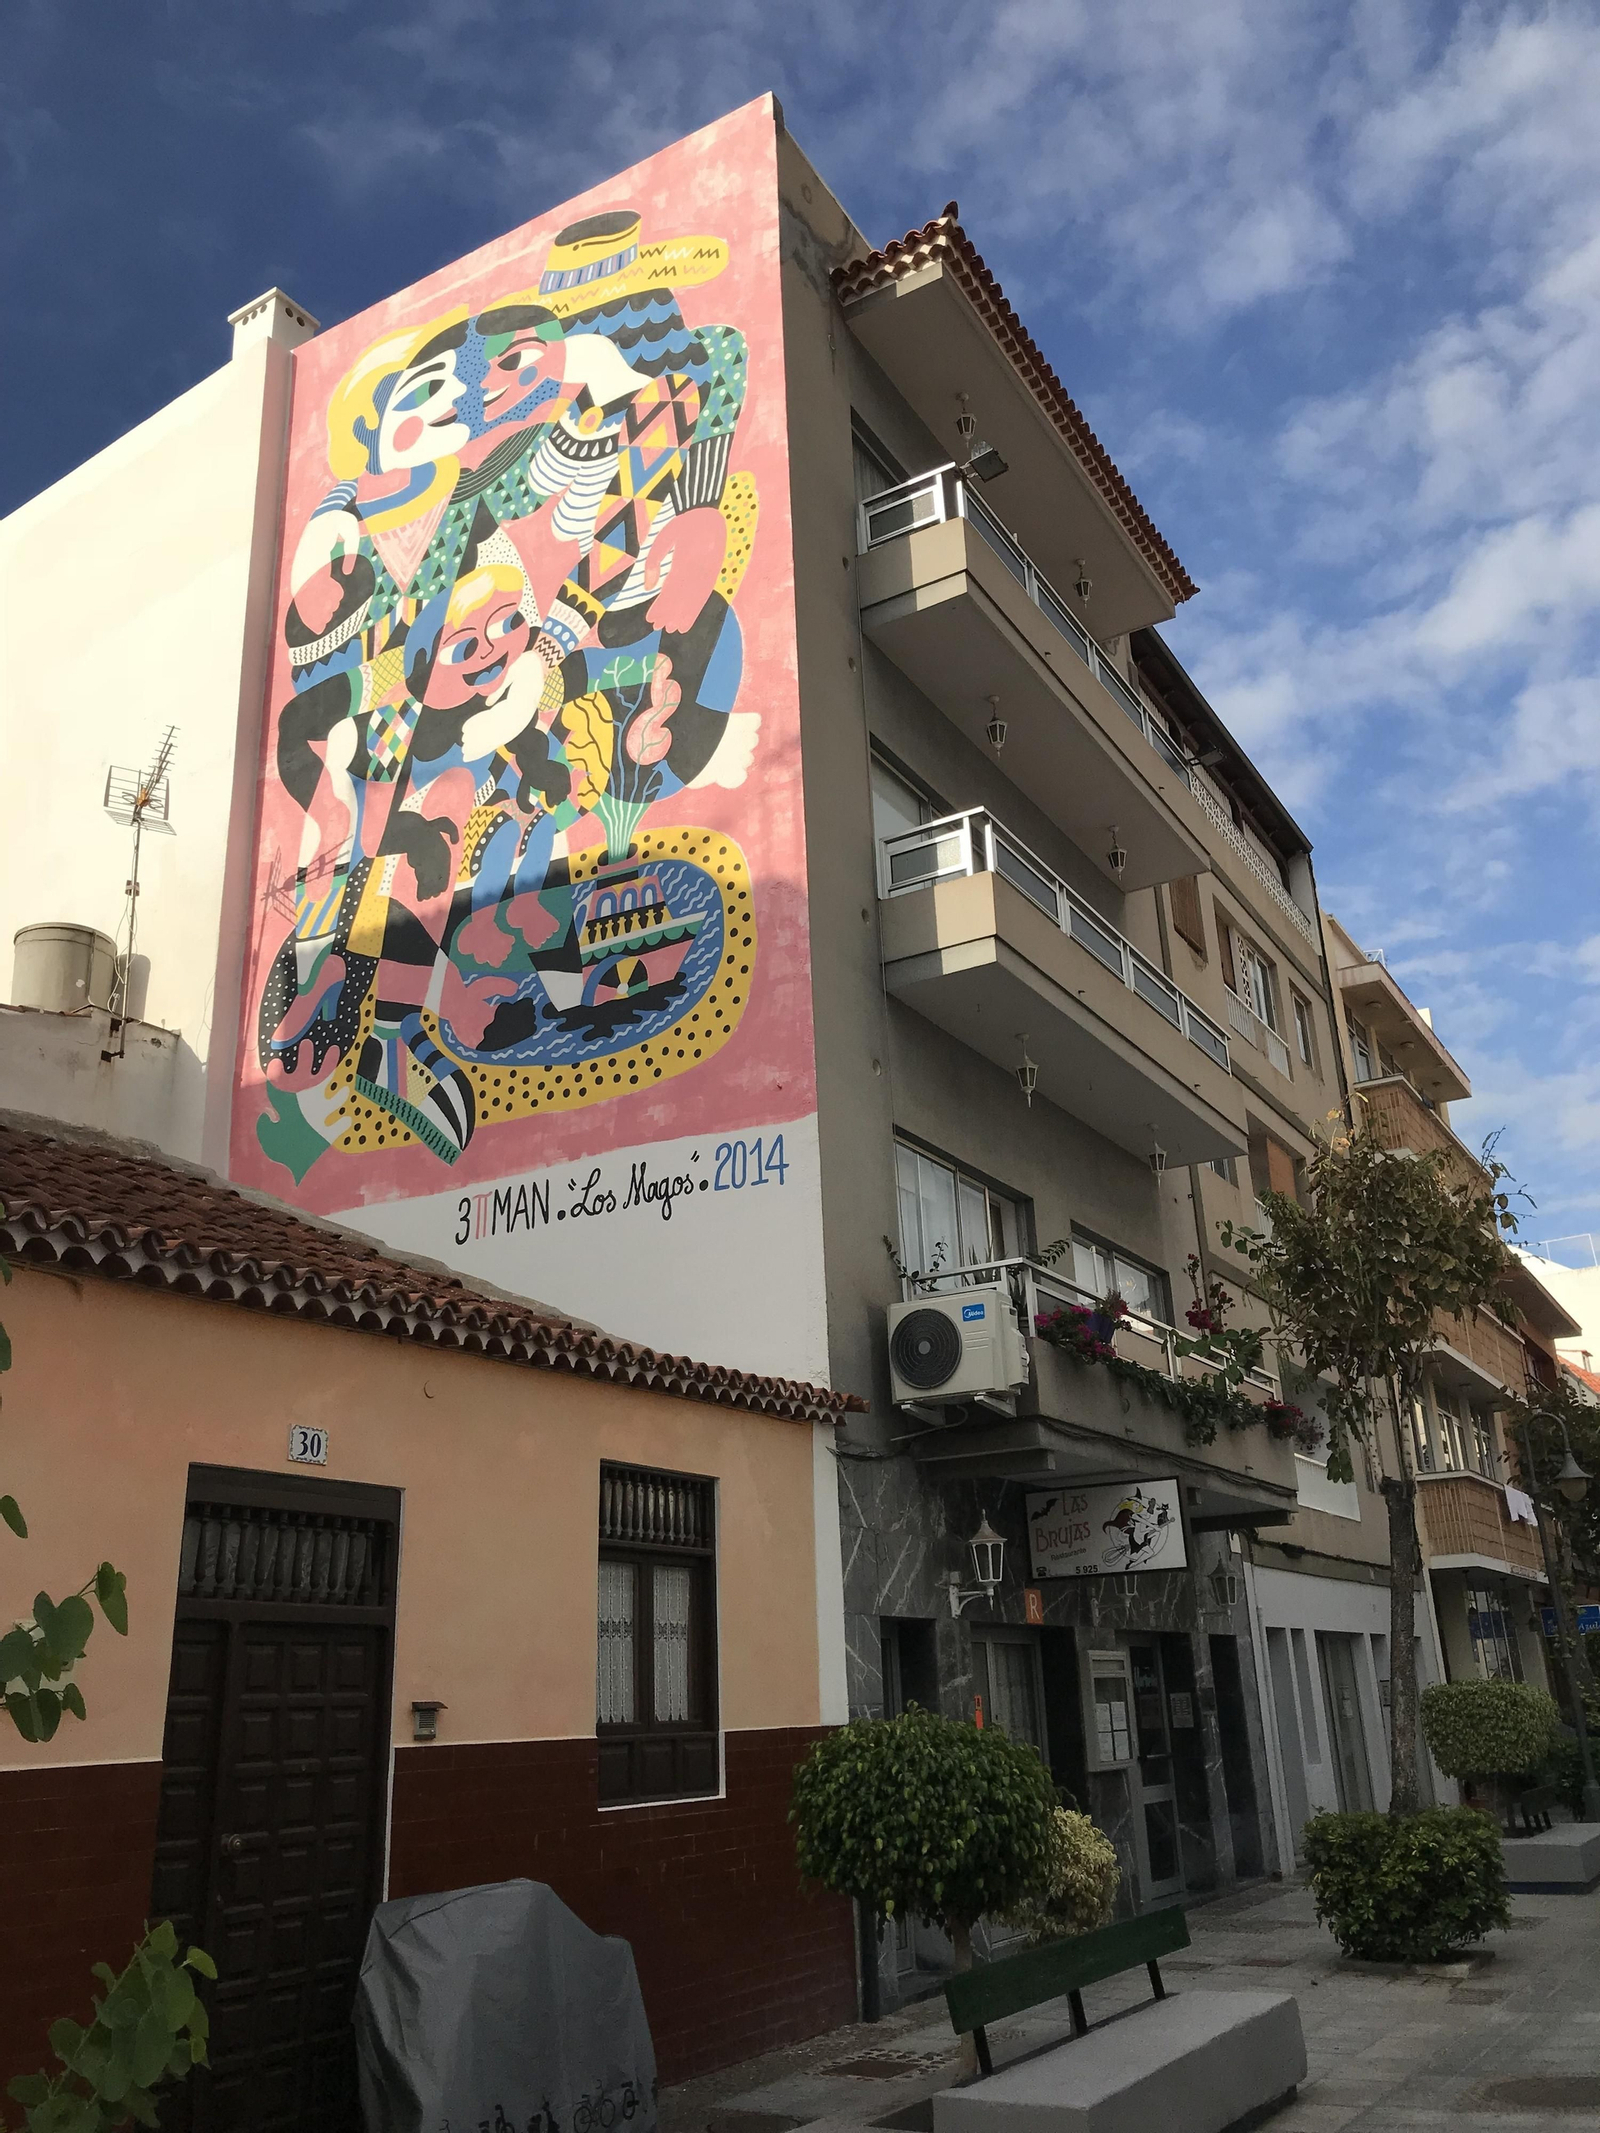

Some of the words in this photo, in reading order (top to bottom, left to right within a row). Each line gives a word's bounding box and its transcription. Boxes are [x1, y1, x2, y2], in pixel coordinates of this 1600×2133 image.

[714, 1134, 790, 1191] 2014
[297, 1431, 322, 1458] 30
[1062, 1491, 1088, 1516] LAS
[1082, 1564, 1099, 1574] 925
[1029, 1593, 1041, 1620] R
